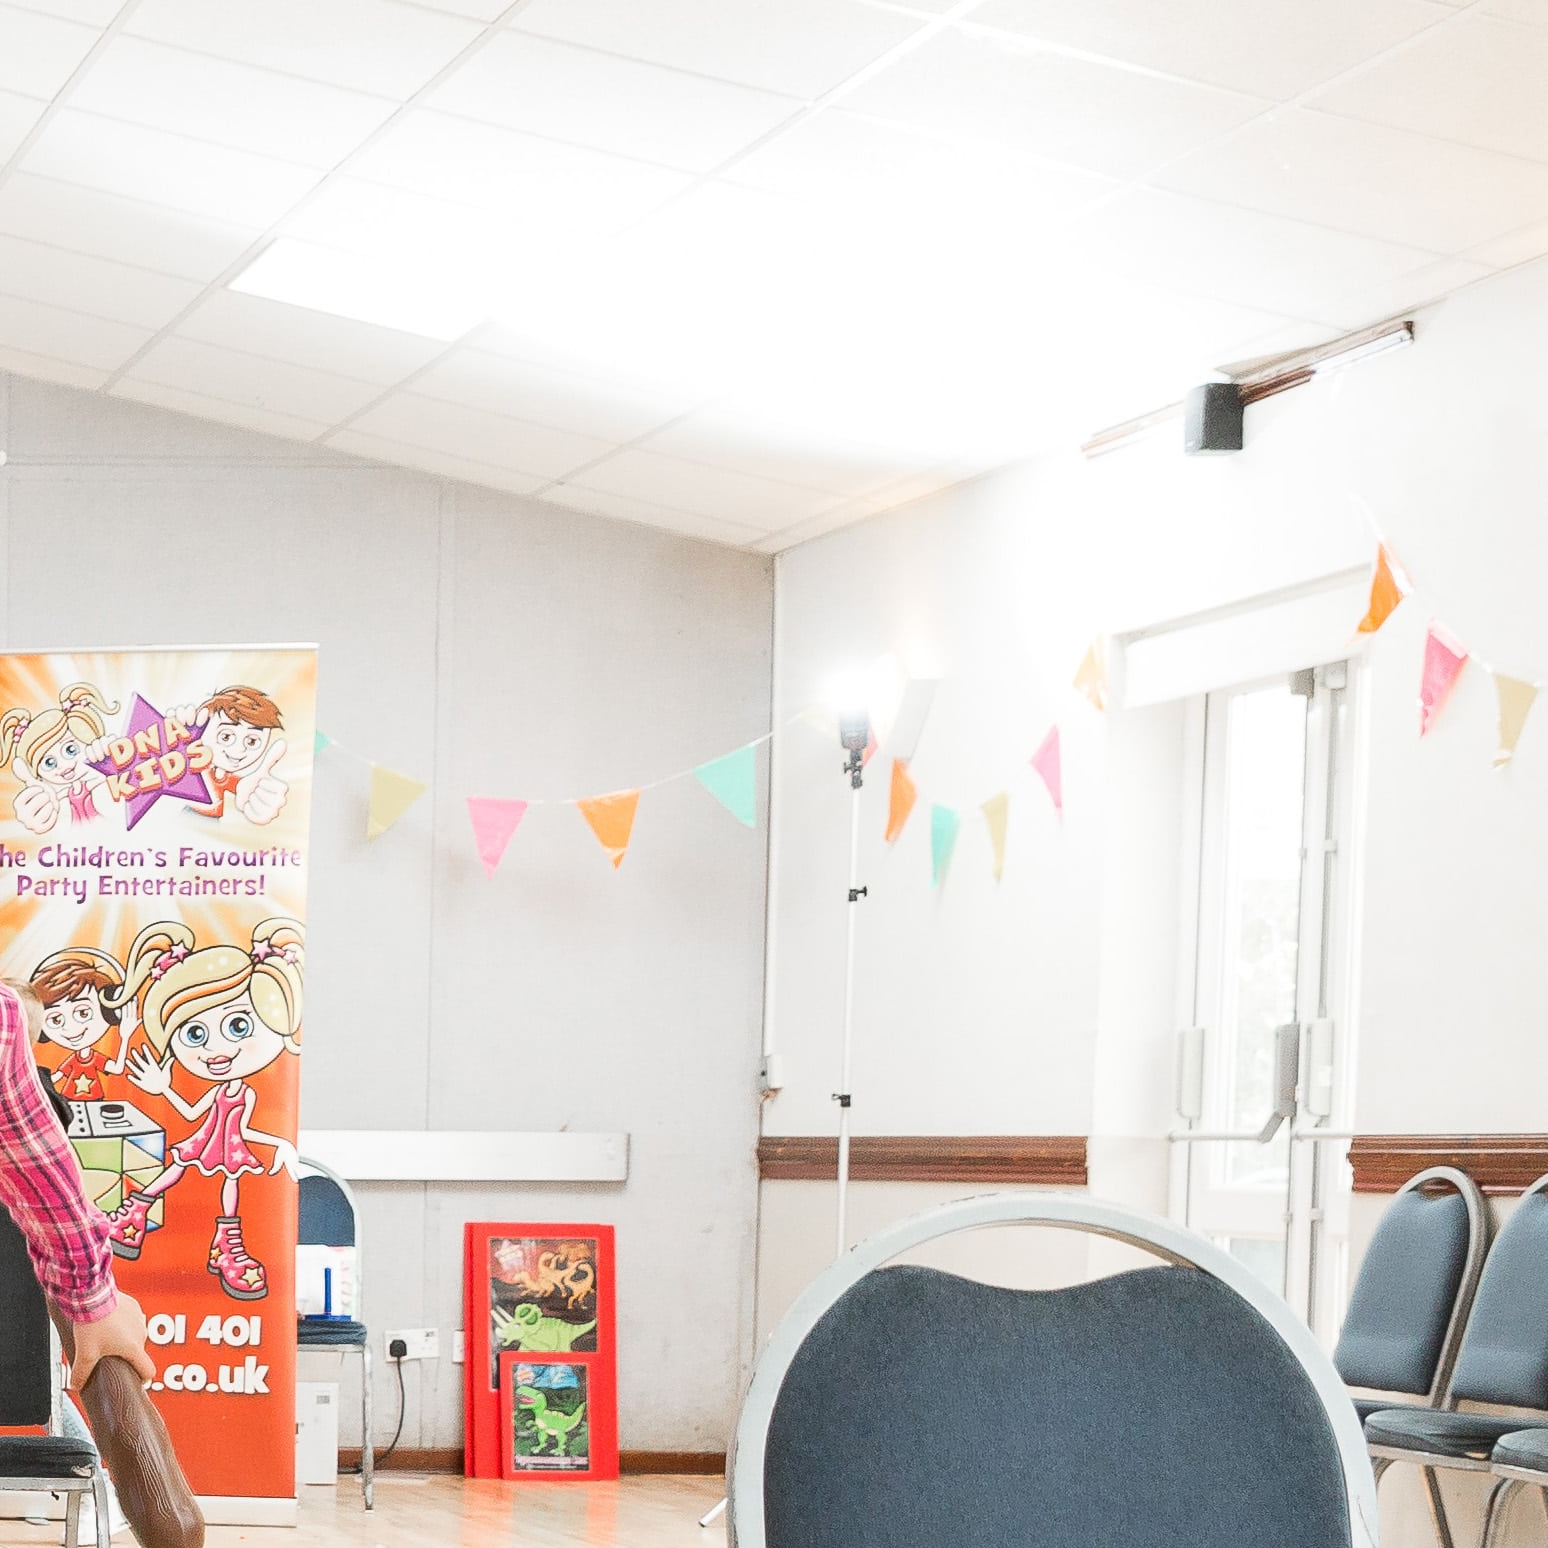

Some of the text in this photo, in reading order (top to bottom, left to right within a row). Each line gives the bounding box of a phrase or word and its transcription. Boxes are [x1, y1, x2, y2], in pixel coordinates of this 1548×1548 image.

[108, 717, 192, 770] DNA
[106, 740, 213, 802] KIDS
[37, 845, 167, 869] Children's
[178, 846, 302, 869] Favourite
[16, 874, 266, 904] Party Entertainers!
[195, 1315, 262, 1347] 401
